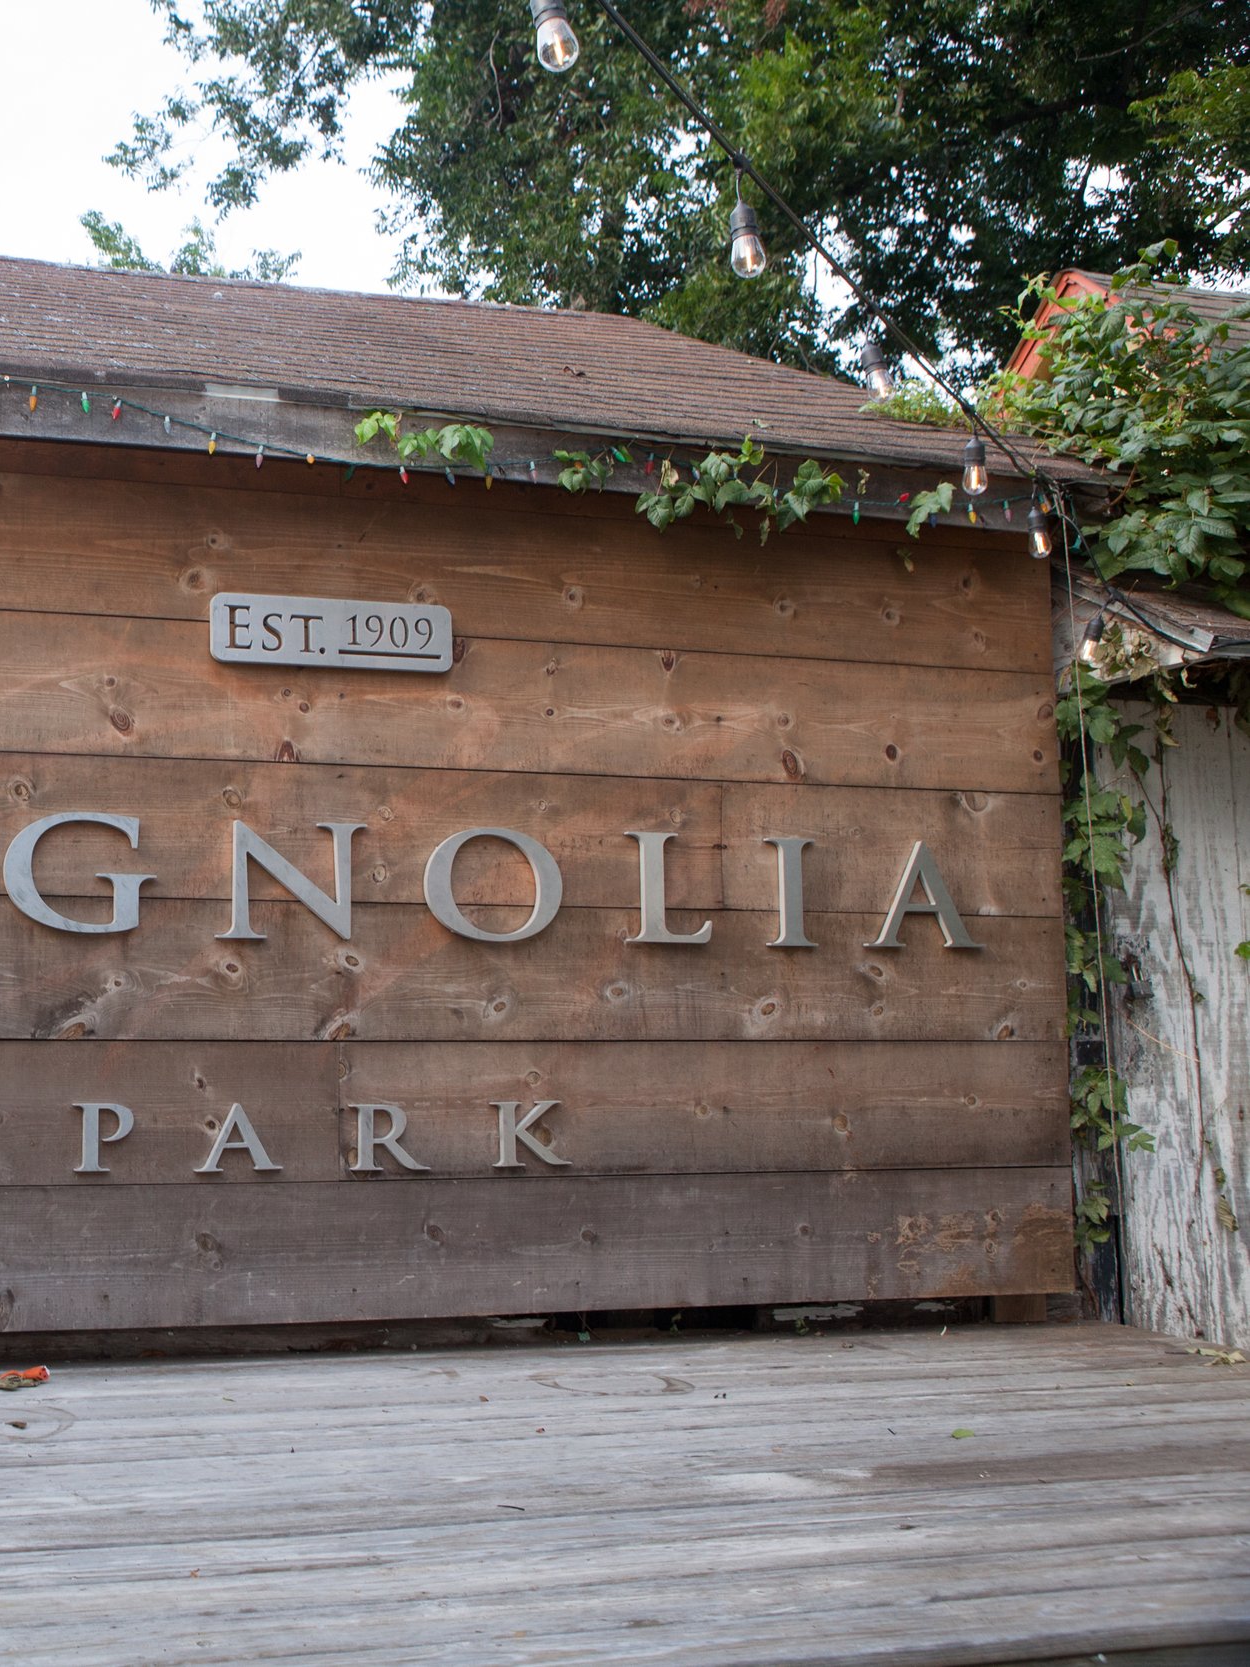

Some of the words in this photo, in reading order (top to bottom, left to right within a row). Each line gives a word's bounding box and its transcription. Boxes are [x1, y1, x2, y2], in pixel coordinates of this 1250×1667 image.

[223, 603, 326, 655] EST.
[346, 613, 435, 650] 1909
[72, 1099, 572, 1175] PARK
